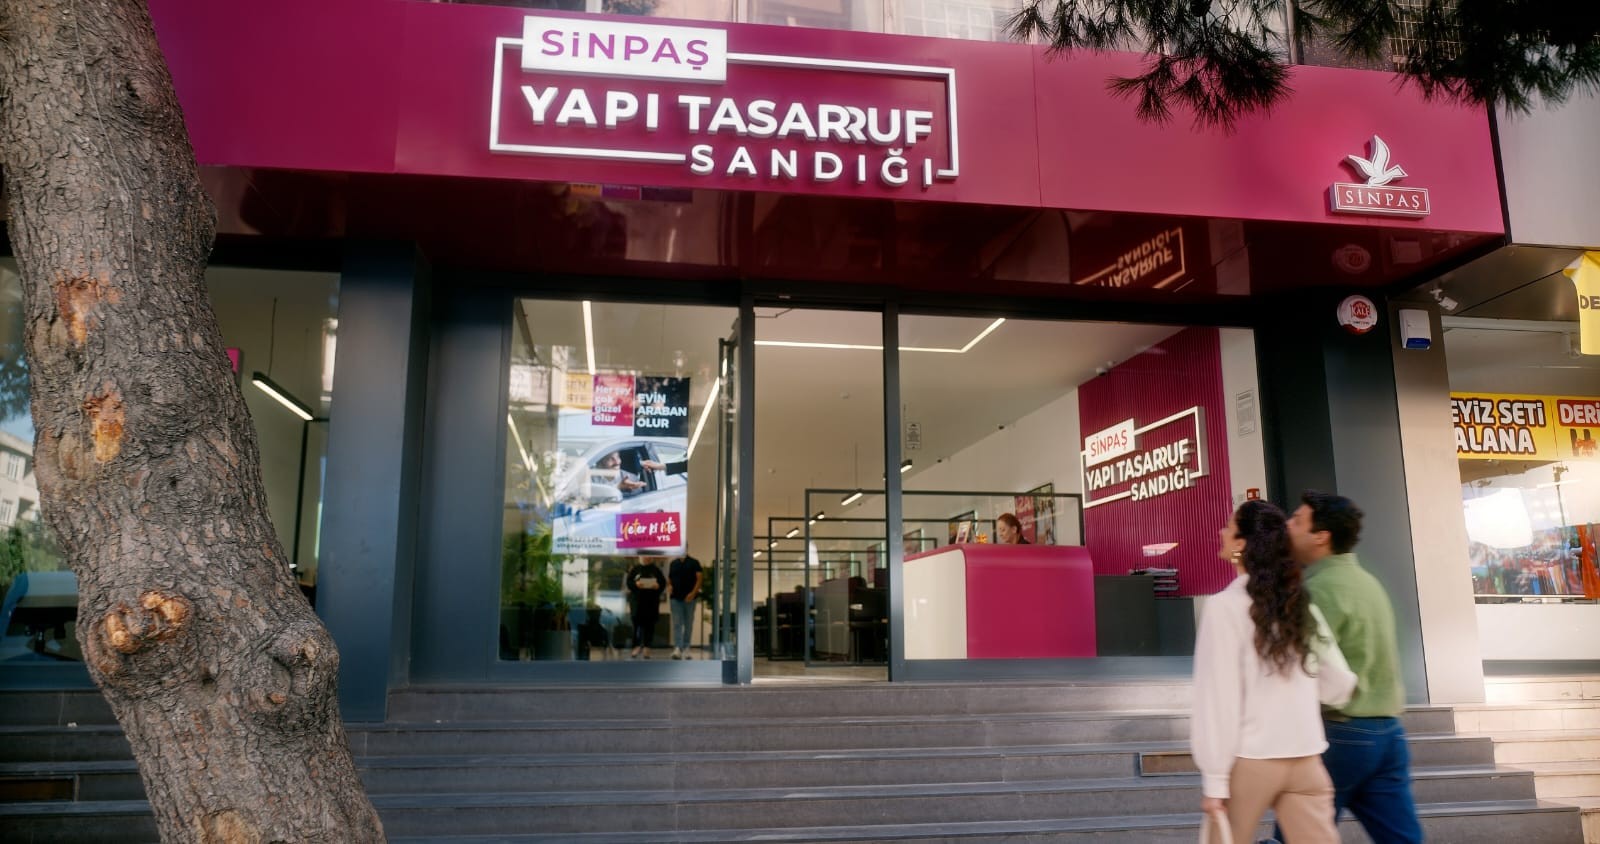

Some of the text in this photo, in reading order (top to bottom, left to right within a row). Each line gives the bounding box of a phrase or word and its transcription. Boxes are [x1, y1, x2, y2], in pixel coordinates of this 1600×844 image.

[521, 85, 934, 146] YAPI TASARRUF
[689, 144, 934, 188] SANDIĞI
[1345, 188, 1420, 210] SİNPAŞ
[594, 404, 621, 413] güzel
[637, 391, 666, 404] EVİN
[594, 413, 617, 422] olur
[636, 418, 669, 428] OLUR
[637, 406, 687, 417] ARABAN
[1090, 429, 1128, 457] SİNPAŞ
[1455, 426, 1535, 454] ALANA
[1086, 438, 1190, 491] YAPI TASARRUF
[1130, 466, 1190, 502] SANDIĞI
